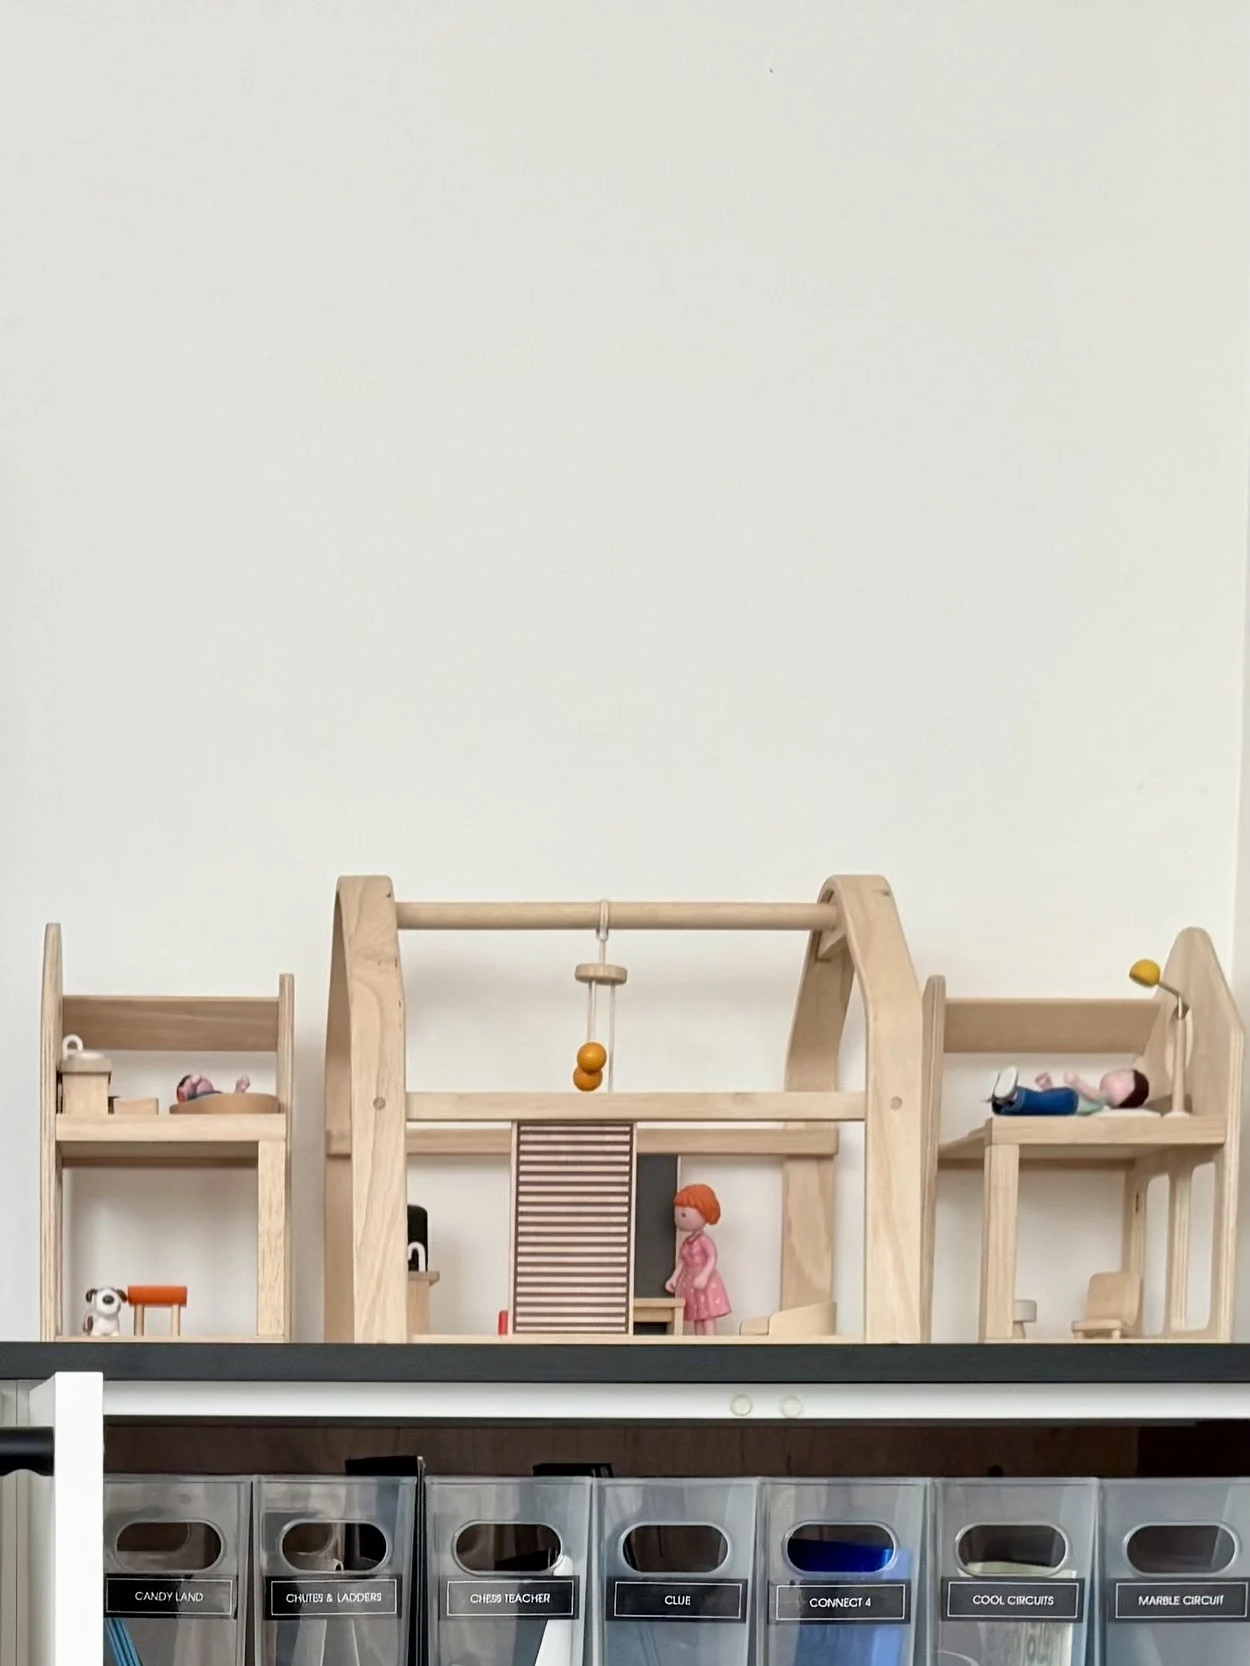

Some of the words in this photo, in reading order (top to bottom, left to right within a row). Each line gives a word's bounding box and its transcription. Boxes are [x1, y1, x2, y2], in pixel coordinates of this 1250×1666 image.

[134, 1590, 174, 1602] CANDY
[175, 1591, 204, 1603] LAND
[285, 1593, 324, 1604] CHUTES
[326, 1593, 334, 1603] &
[337, 1592, 383, 1603] LADDERS
[469, 1593, 503, 1605] CHESS
[504, 1593, 551, 1604] TEACHER
[664, 1595, 691, 1606] CLUE
[809, 1597, 863, 1608] CONNECT
[864, 1597, 872, 1608] 4
[972, 1594, 1005, 1606] COOL
[1007, 1594, 1054, 1606] CIRCUITS
[1138, 1595, 1181, 1607] MARBLE
[1182, 1594, 1225, 1606] CIRCUIT
